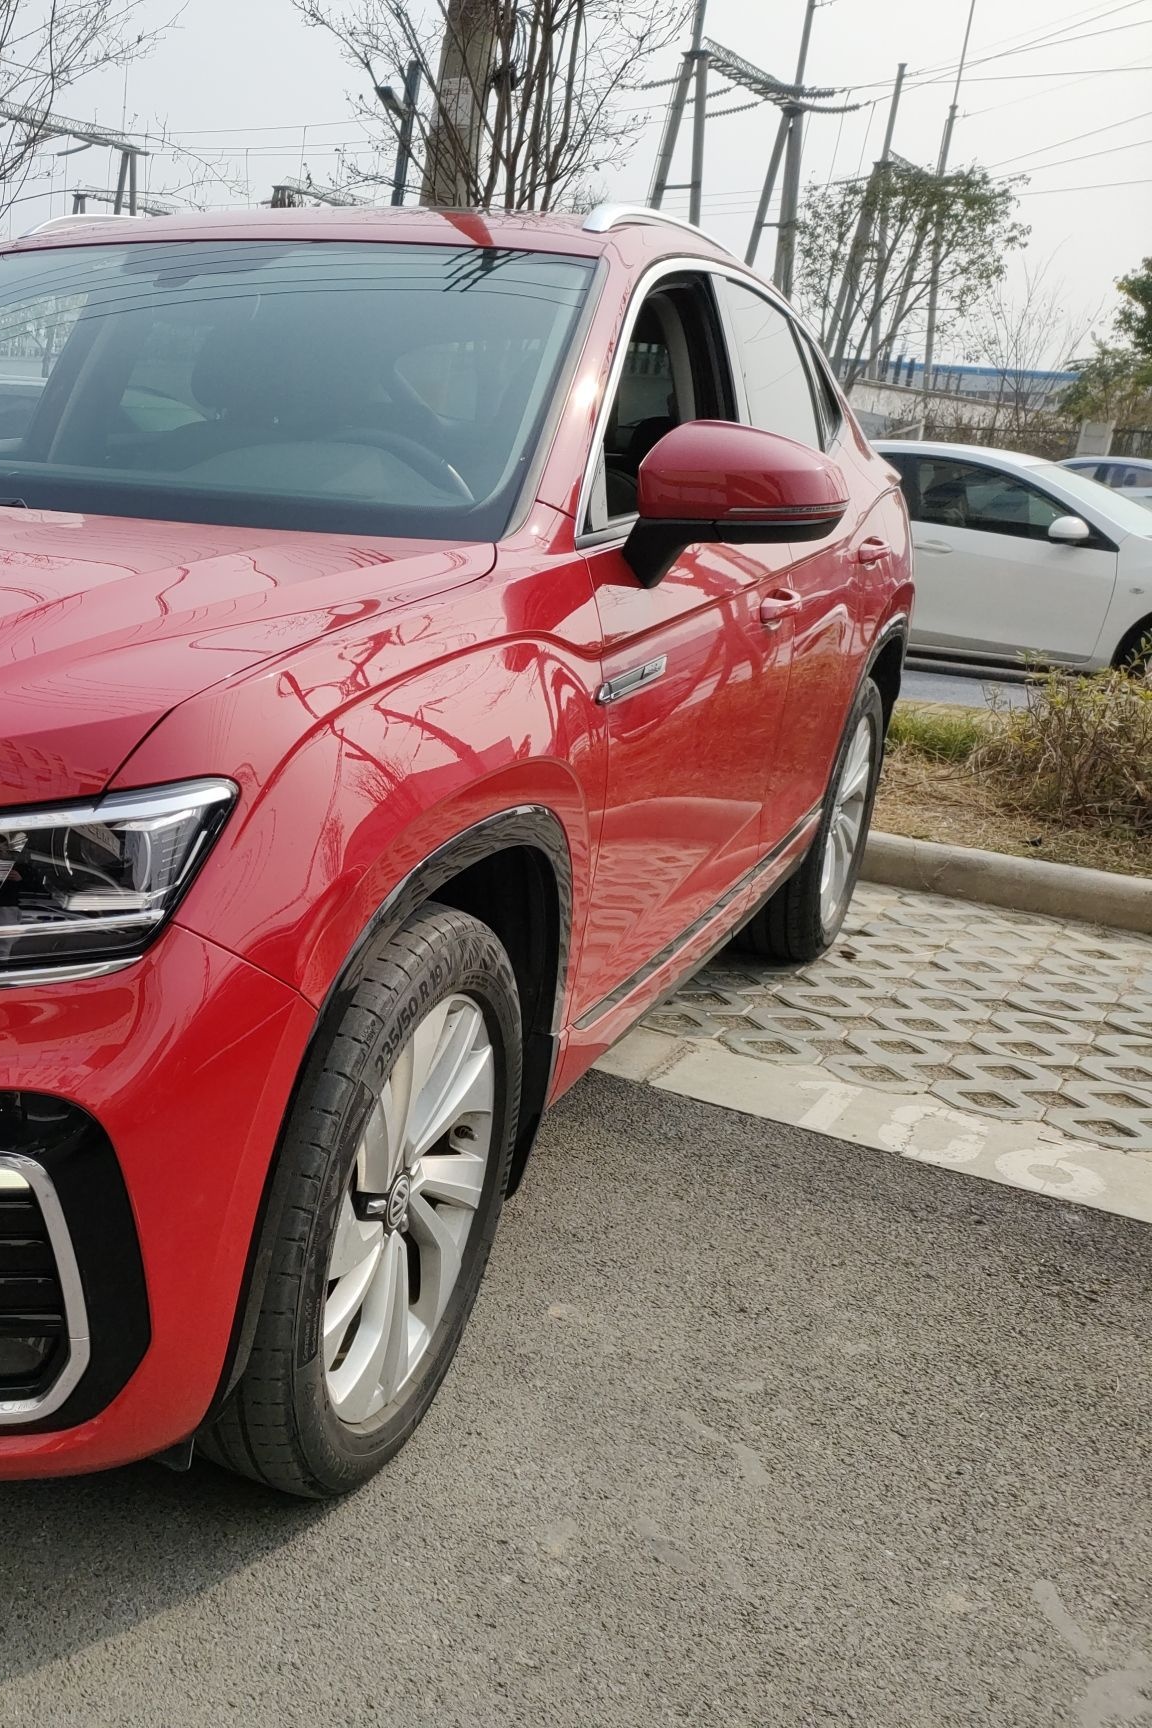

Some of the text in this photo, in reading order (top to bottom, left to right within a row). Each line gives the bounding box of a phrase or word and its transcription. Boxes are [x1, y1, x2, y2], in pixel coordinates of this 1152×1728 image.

[375, 997, 419, 1076] 235/50
[419, 980, 431, 1000] R
[429, 964, 444, 991] 19
[795, 1079, 1107, 1199] 106
